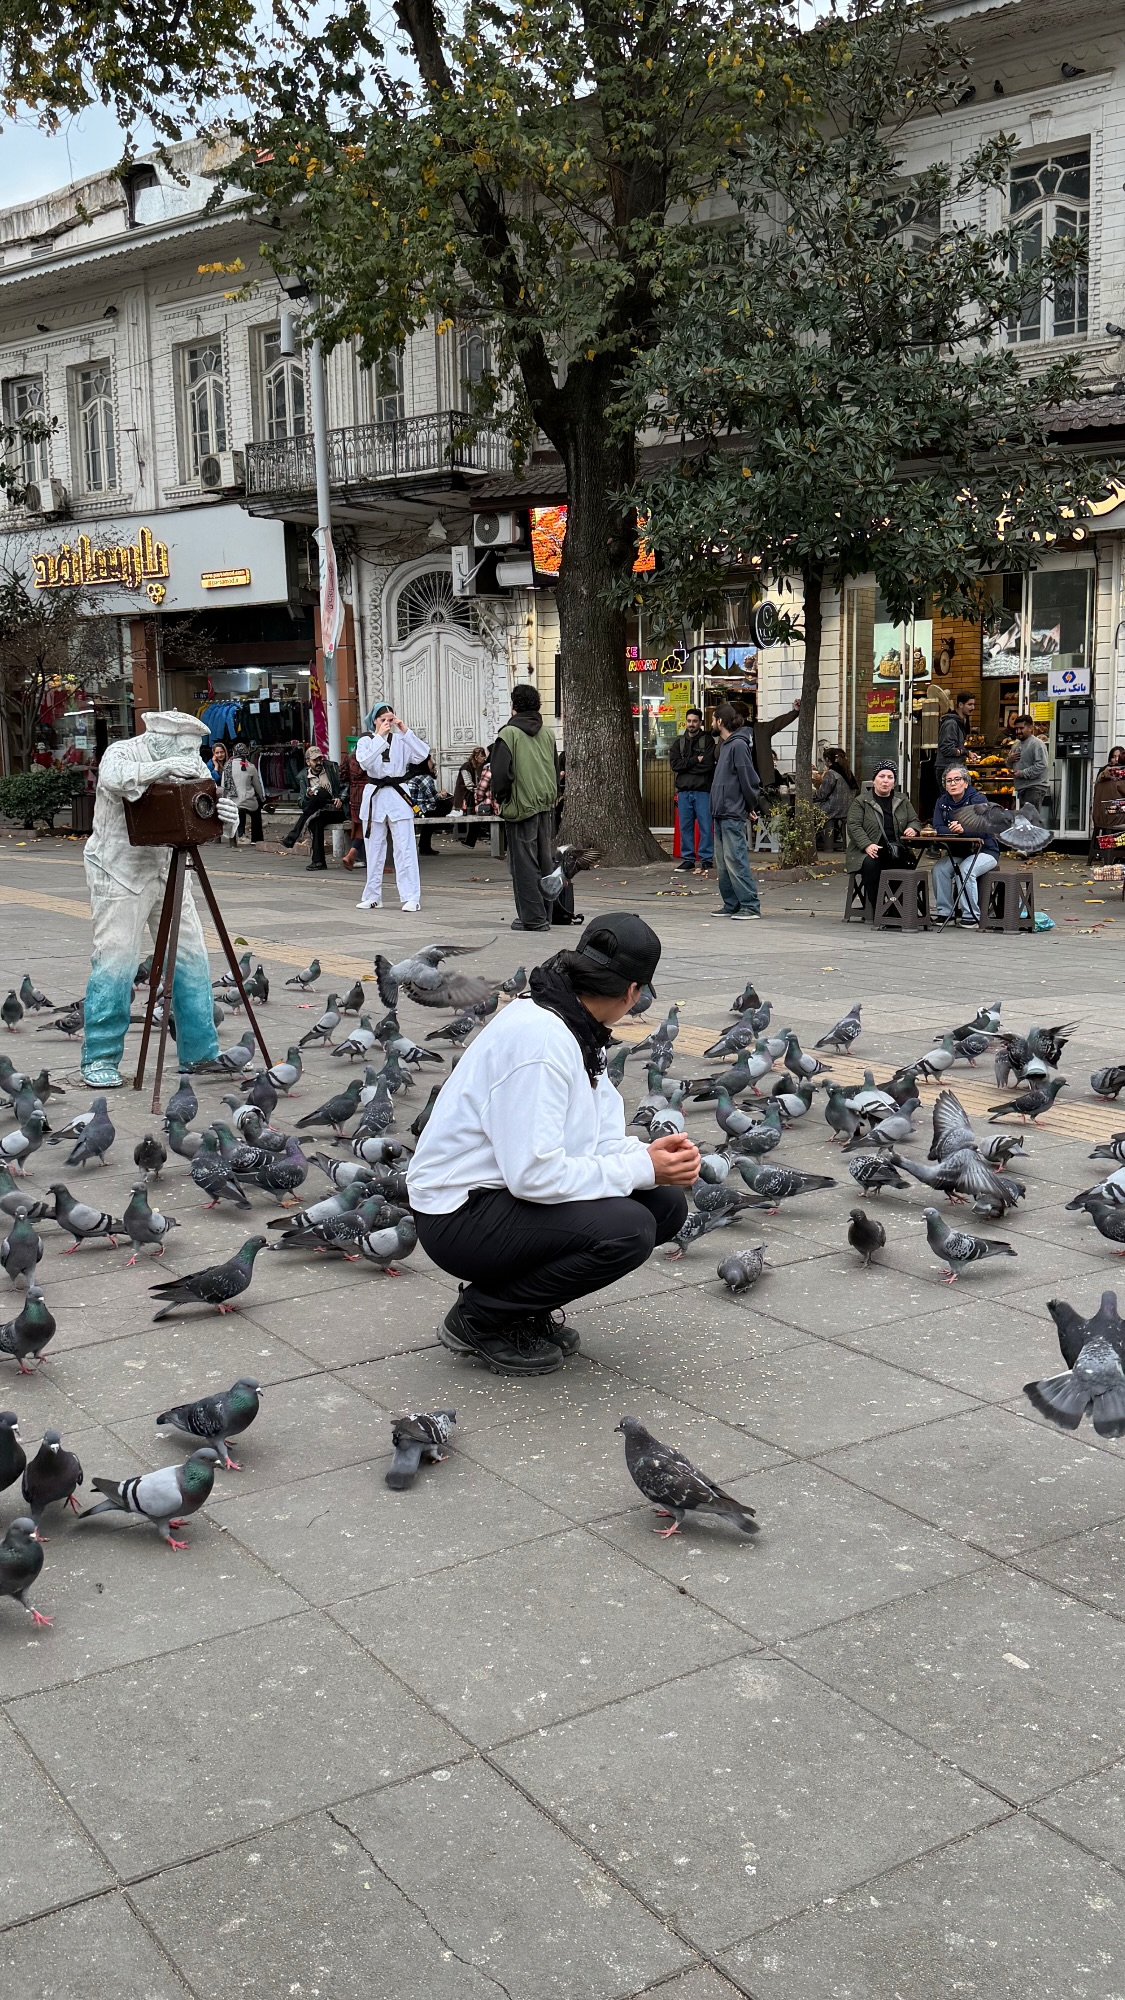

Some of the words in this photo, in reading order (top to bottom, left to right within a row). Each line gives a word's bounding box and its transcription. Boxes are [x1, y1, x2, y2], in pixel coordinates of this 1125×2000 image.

[628, 658, 659, 672] AWAY
[667, 682, 688, 692] وافل
[1052, 685, 1067, 695] سینا
[1068, 683, 1086, 694] بانک
